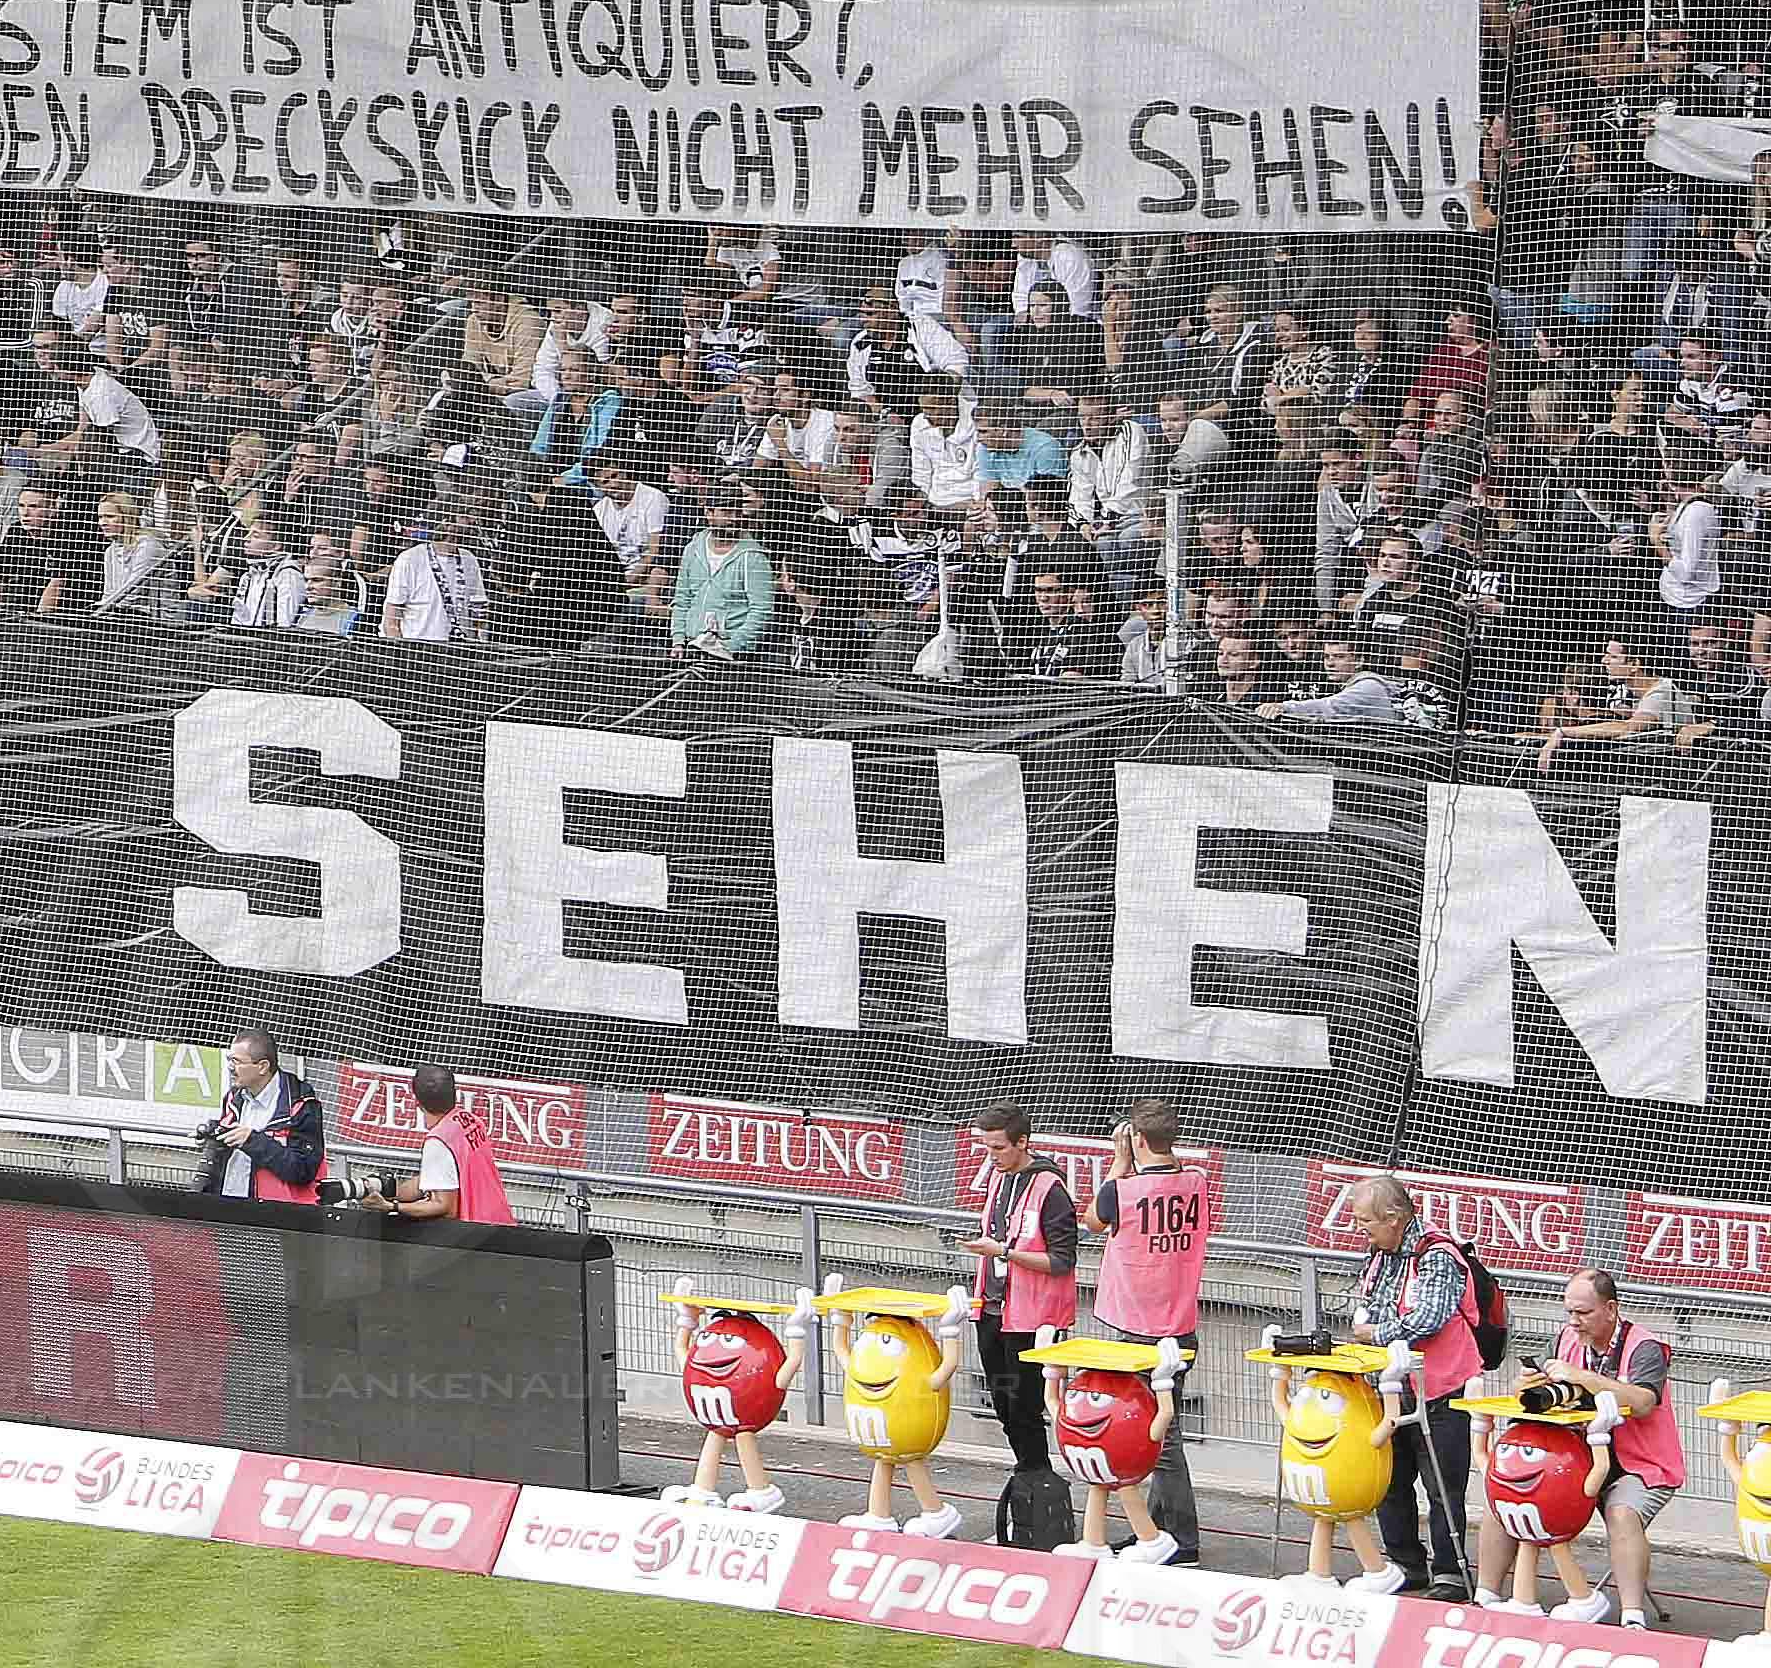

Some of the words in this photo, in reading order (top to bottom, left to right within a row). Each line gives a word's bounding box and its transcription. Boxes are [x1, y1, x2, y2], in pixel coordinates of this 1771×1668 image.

[140, 81, 574, 209] DRECKSKICK
[611, 101, 823, 214] NICHT
[857, 99, 1084, 222] MEHR
[1127, 95, 1469, 230] SEHEN!
[171, 687, 1712, 1104] SEHEN
[660, 1105, 895, 1182] ZEITUNG
[1136, 1193, 1200, 1235] 1164
[1321, 1178, 1571, 1254] ZTUNG
[1148, 1232, 1192, 1254] FOTO
[138, 1456, 215, 1484] BUNDES
[126, 1475, 205, 1514] LIGA
[259, 1461, 472, 1551] tipico
[524, 1516, 621, 1555] tipico
[699, 1522, 780, 1551] BUNDES
[687, 1544, 771, 1585] LIGA
[827, 1530, 1050, 1623] tipico
[1099, 1586, 1200, 1630] tipico
[1280, 1601, 1369, 1629] BUNDES
[1269, 1624, 1357, 1665] LIGA
